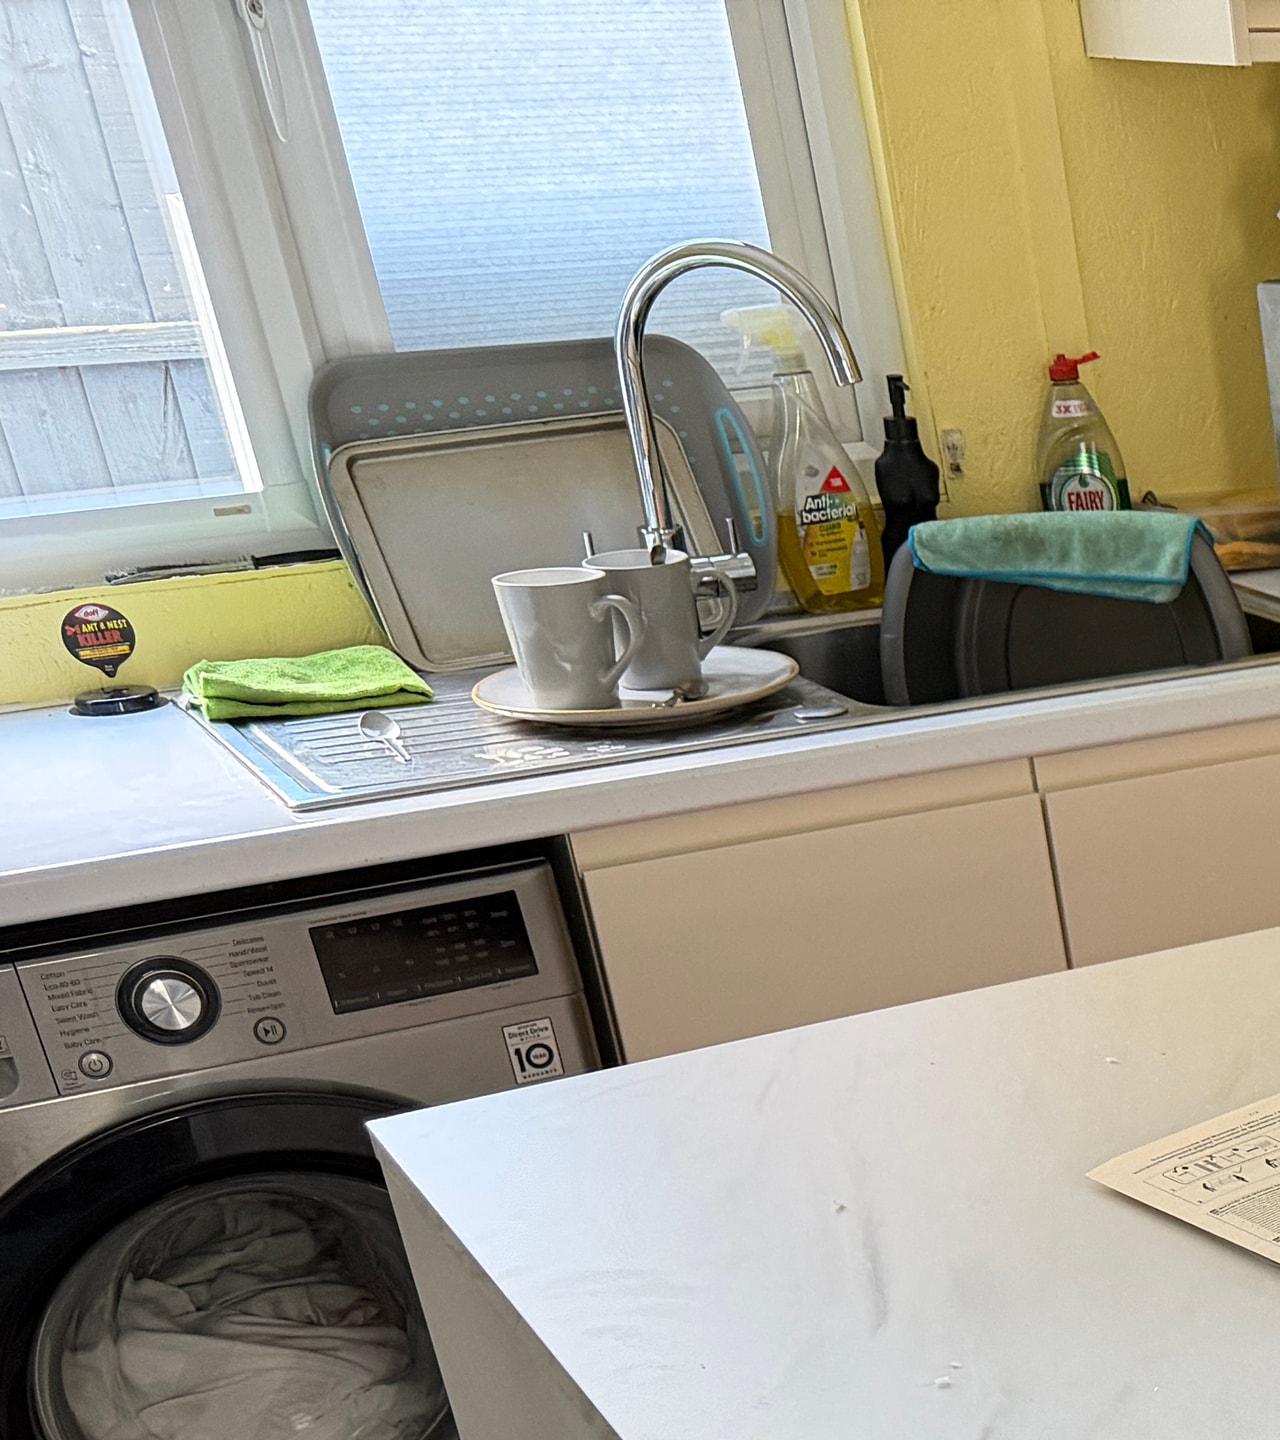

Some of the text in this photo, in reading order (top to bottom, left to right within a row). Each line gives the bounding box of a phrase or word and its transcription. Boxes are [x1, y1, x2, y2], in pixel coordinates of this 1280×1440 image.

[1067, 490, 1104, 511] FAIRY
[802, 504, 857, 523] bacterial
[82, 622, 99, 633] ANT
[106, 619, 128, 630] NEST
[77, 629, 124, 647] KILLER
[508, 1026, 549, 1040] Direct Drive
[514, 1042, 554, 1073] 10
